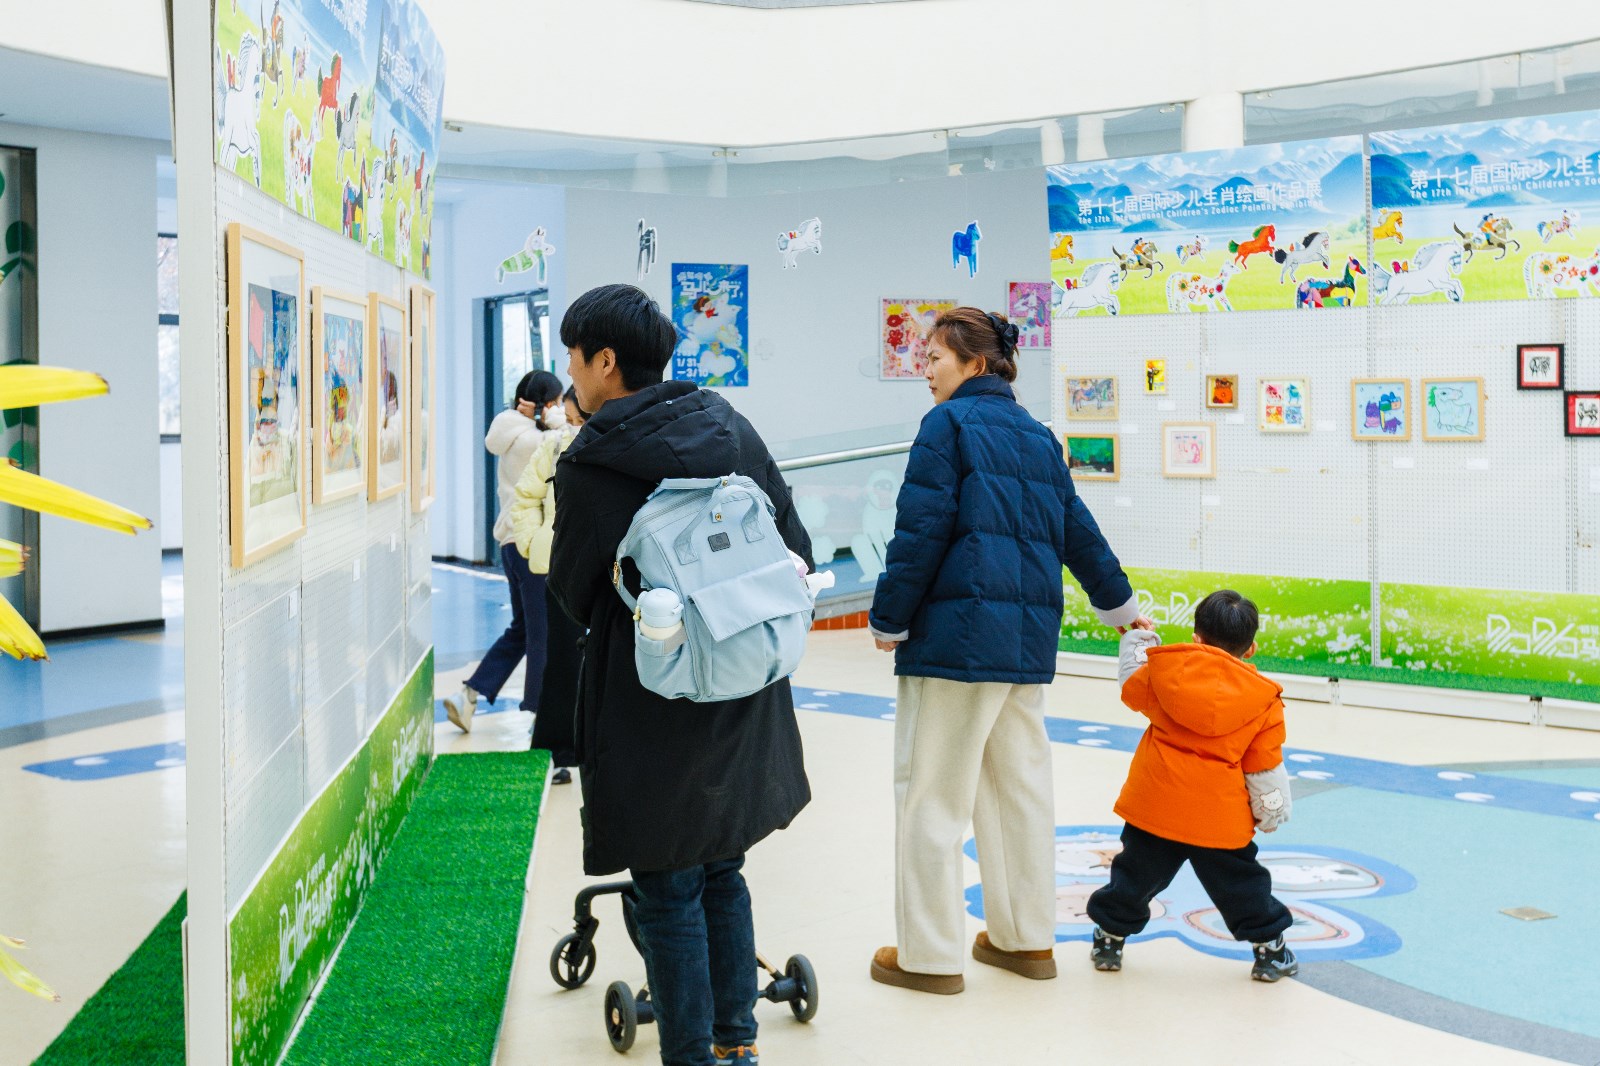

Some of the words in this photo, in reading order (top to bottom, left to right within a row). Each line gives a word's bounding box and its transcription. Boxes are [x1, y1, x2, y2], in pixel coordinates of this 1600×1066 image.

[1077, 179, 1323, 217] 第十七届国际少儿生肖绘画作品展
[1411, 190, 1427, 199] The
[1431, 188, 1452, 198] 17th
[1455, 183, 1521, 195] International
[1525, 176, 1580, 190] Children's
[1078, 216, 1092, 225] The
[1095, 215, 1110, 224] 17th
[1166, 208, 1209, 219] Children's
[1211, 205, 1239, 215] Zodiac
[1242, 202, 1277, 213] Painting
